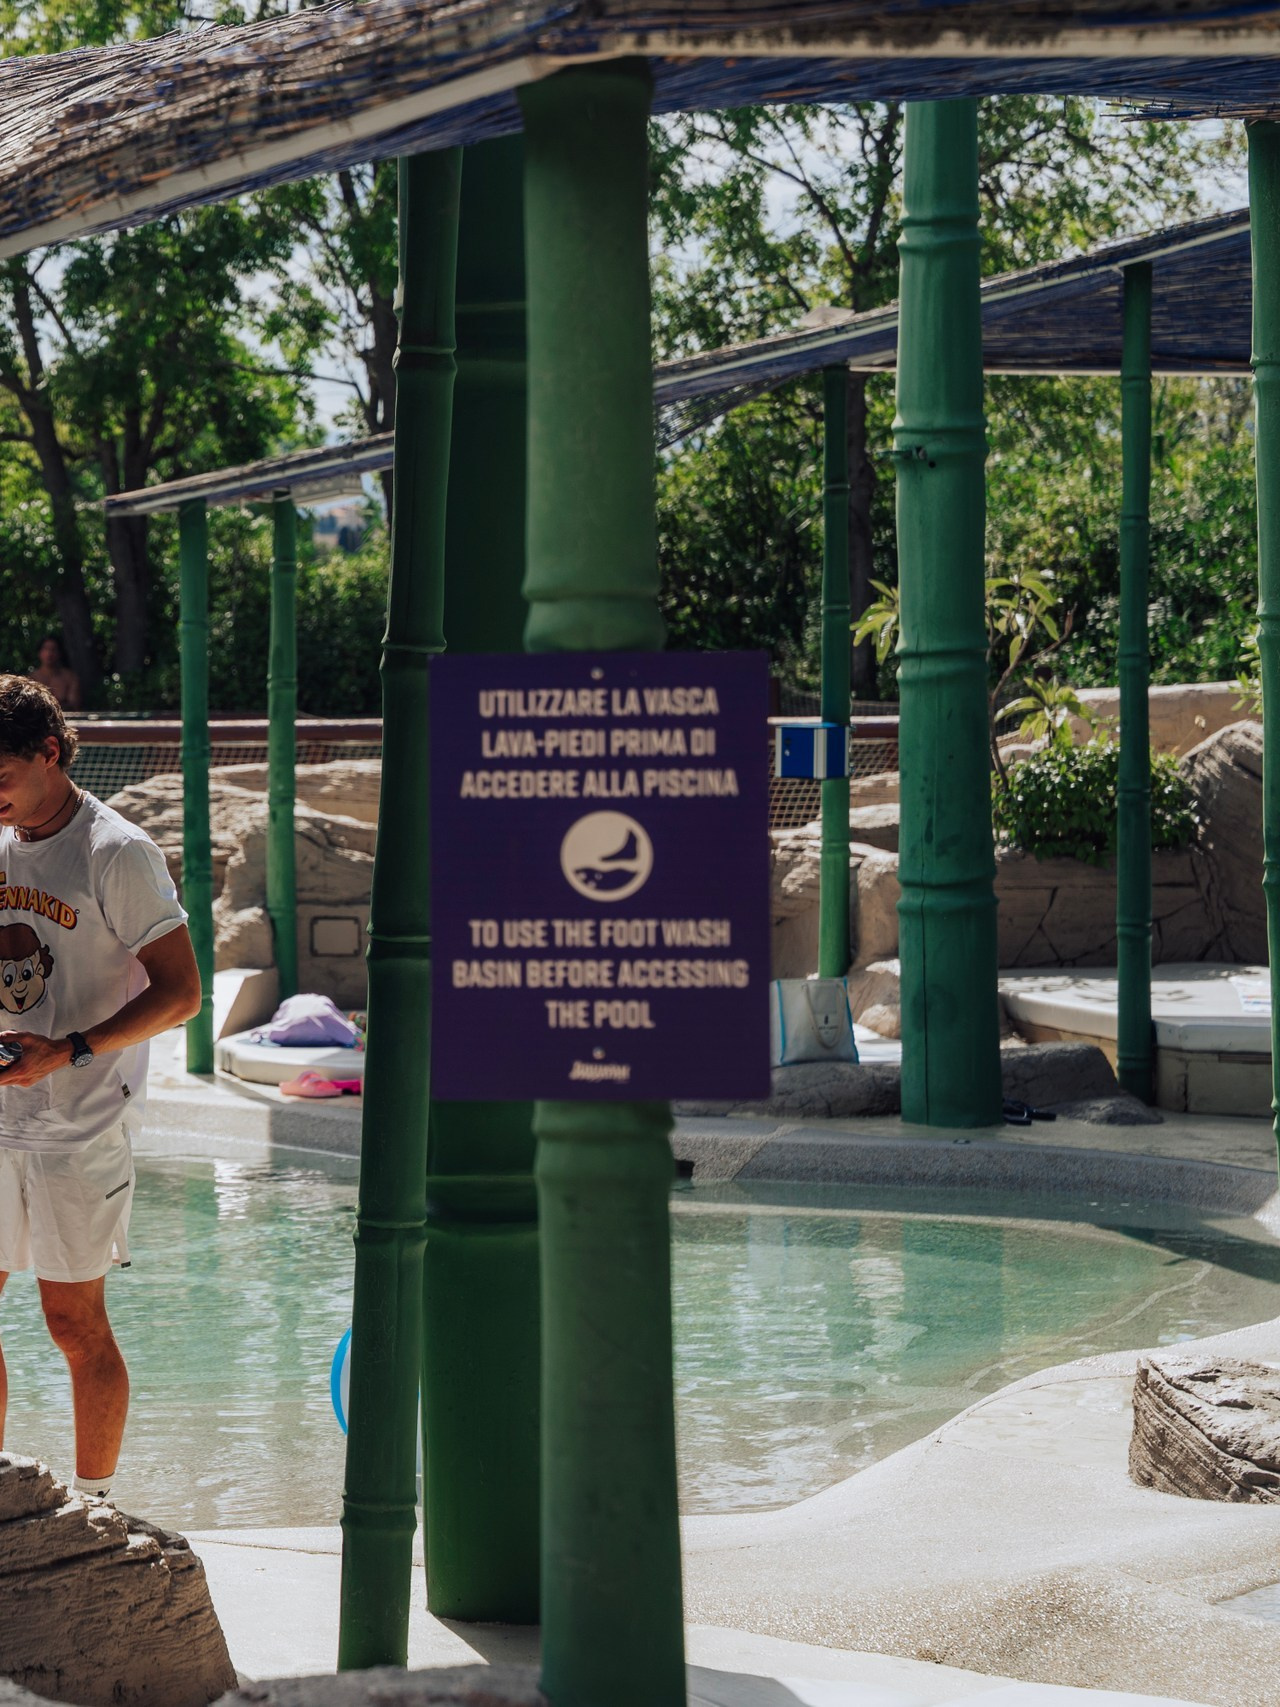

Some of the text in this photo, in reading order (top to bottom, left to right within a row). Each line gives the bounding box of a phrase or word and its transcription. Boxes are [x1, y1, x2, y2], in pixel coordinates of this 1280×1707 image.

[479, 687, 719, 717] UTILIZZARE LA VASCA
[481, 728, 716, 758] LAVA-PIEDI PRIMA DI
[460, 768, 739, 799] ACCEDERE ALLA PISCINA
[469, 919, 731, 948] TO USE THE FOOT WASH
[452, 959, 749, 988] BASIN BEFORE ACCESSING
[545, 1000, 655, 1029] THE POOL
